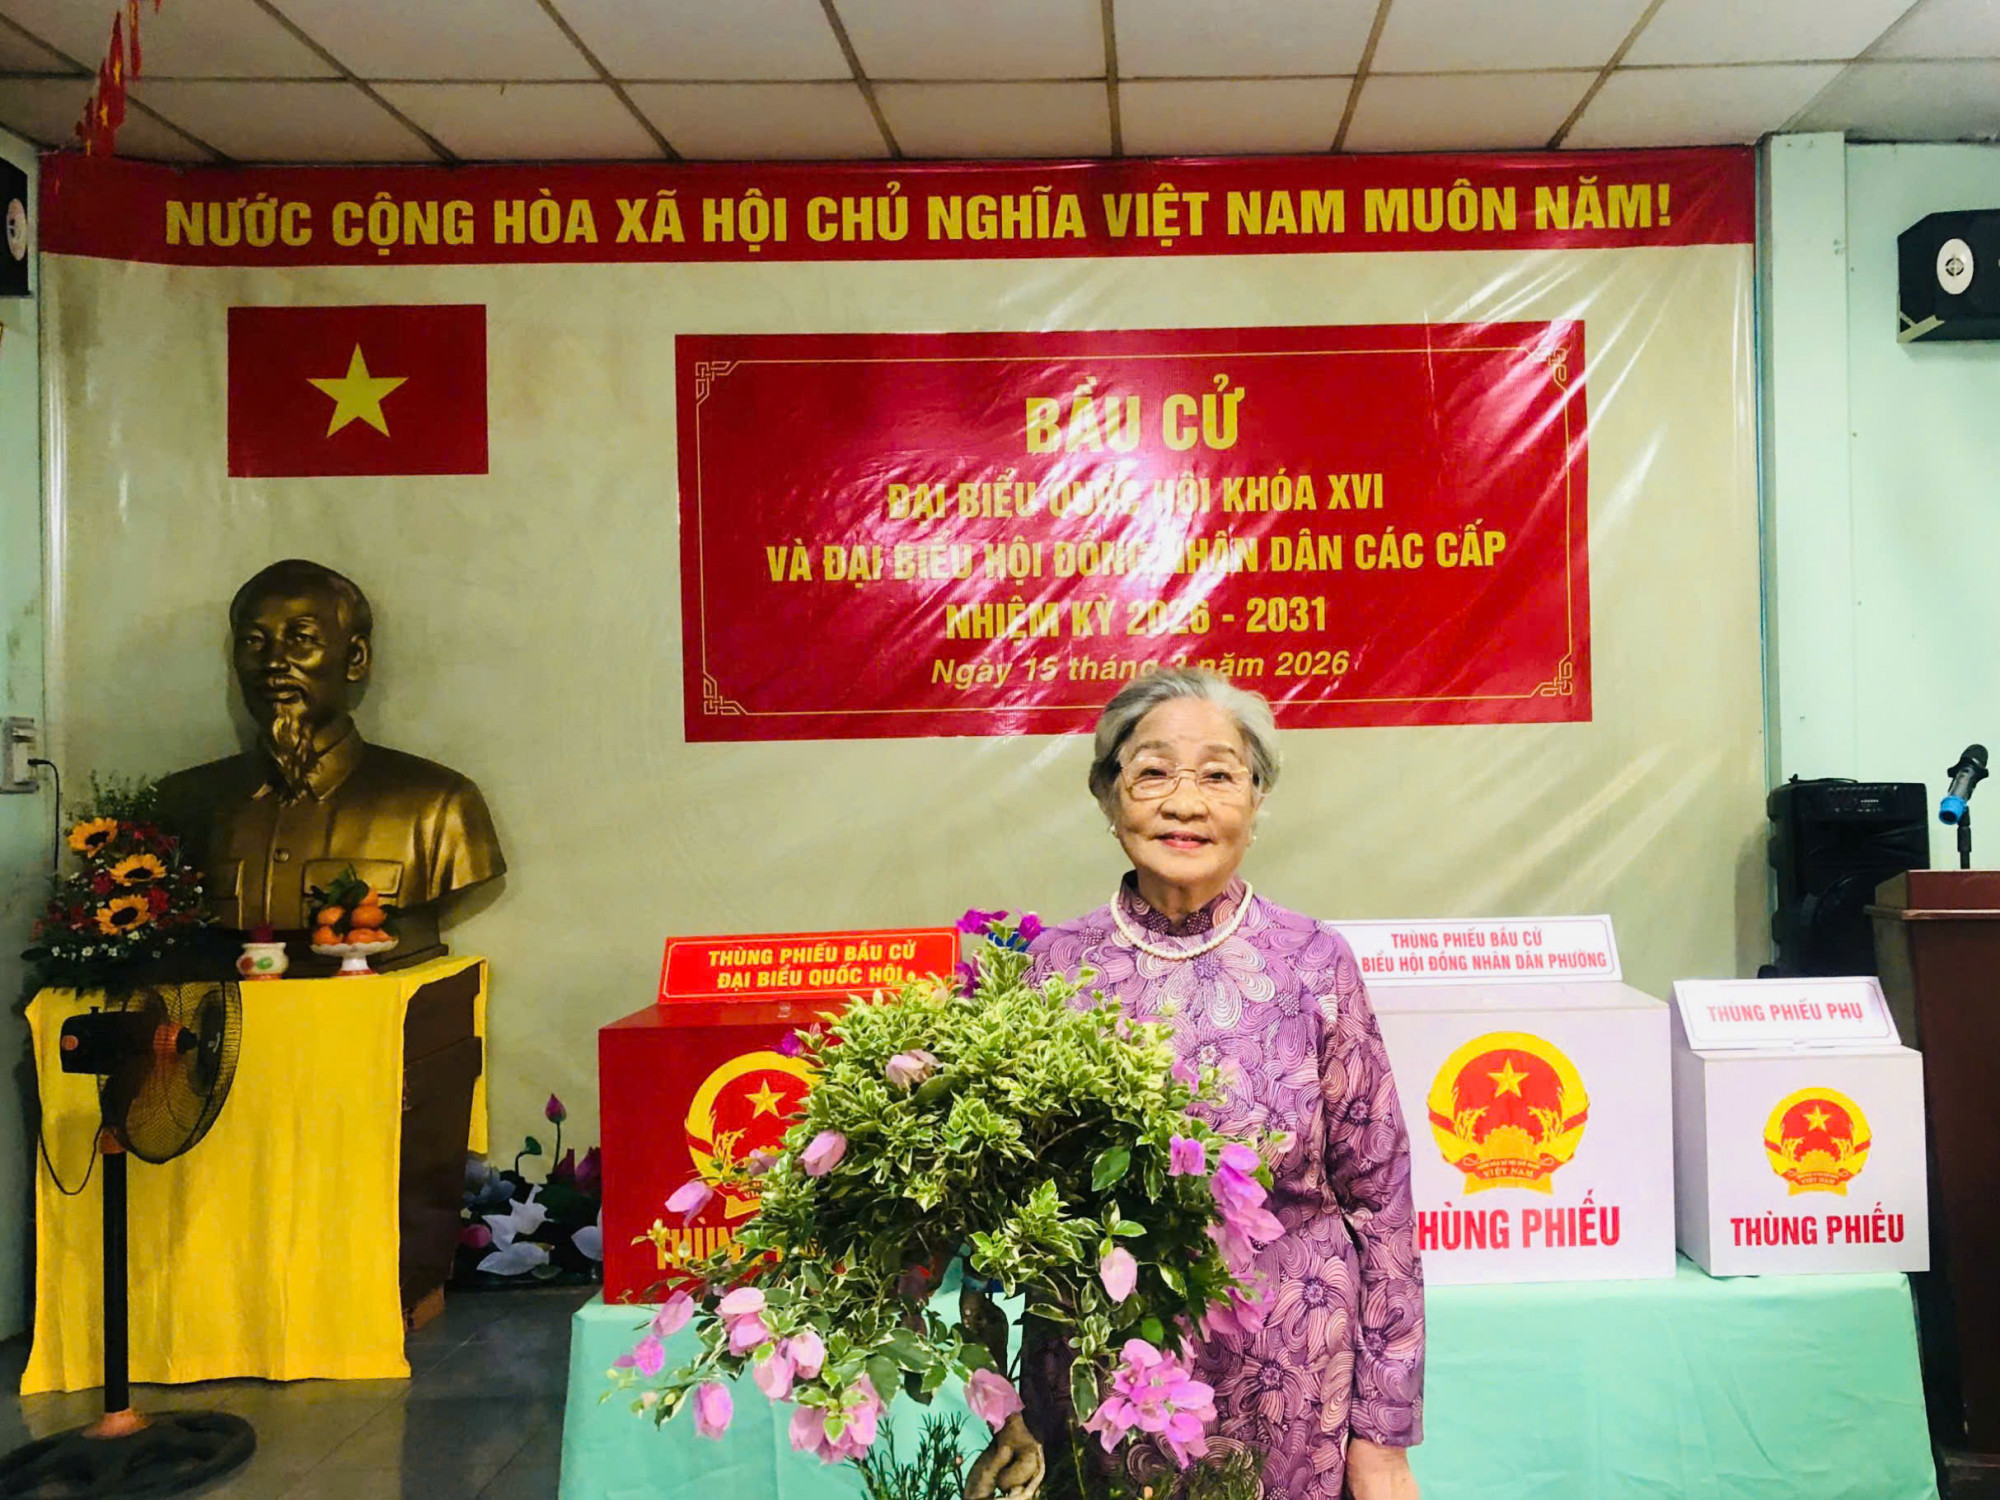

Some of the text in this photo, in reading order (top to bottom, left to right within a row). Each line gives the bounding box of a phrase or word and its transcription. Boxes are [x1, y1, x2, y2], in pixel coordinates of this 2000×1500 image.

[166, 175, 1671, 255] NƯỚC CỘNG HÒA XÃ HỘI CHỦ NGHĨA VIỆT NAM MUÔN NĂM!
[1026, 373, 1245, 453] BẦU CỬ
[888, 483, 946, 527] ĐẠI
[958, 467, 1037, 519] BIỂU
[1222, 468, 1316, 513] KHÓA
[1328, 473, 1383, 511] XVI
[766, 538, 813, 582] VÀ
[823, 544, 882, 589] ĐẠI
[893, 529, 972, 580] BIỂU
[984, 535, 1042, 586] HỘI
[1271, 528, 1343, 572] DÂN
[1355, 526, 1424, 570] CÁC
[1436, 518, 1506, 567] CẤP
[946, 592, 1326, 646] NHIỆM KỲ 2026 - 2031
[931, 657, 1013, 689] Ngày
[1026, 656, 1059, 681] 15
[1199, 652, 1265, 677] năm
[1274, 650, 1351, 676] 2026
[708, 946, 773, 967] THÙNG
[779, 941, 838, 964] PHIẾU
[890, 939, 917, 960] CỬ
[1391, 930, 1439, 949] THÙNG
[1443, 926, 1486, 947] PHIẾU
[717, 971, 751, 991] ĐẠI
[809, 963, 863, 987] QUỐC
[869, 963, 903, 985] HỘI
[1400, 951, 1424, 975] HỘI
[1472, 950, 1512, 970] NHÂN
[1515, 949, 1544, 969] DÂN
[1770, 998, 1823, 1022] PHIẾU
[1826, 1002, 1865, 1024] PHỤ
[1418, 1188, 1621, 1250] HÙNG PHIẾU
[1731, 1202, 1905, 1247] THÙNG PHIẾU
